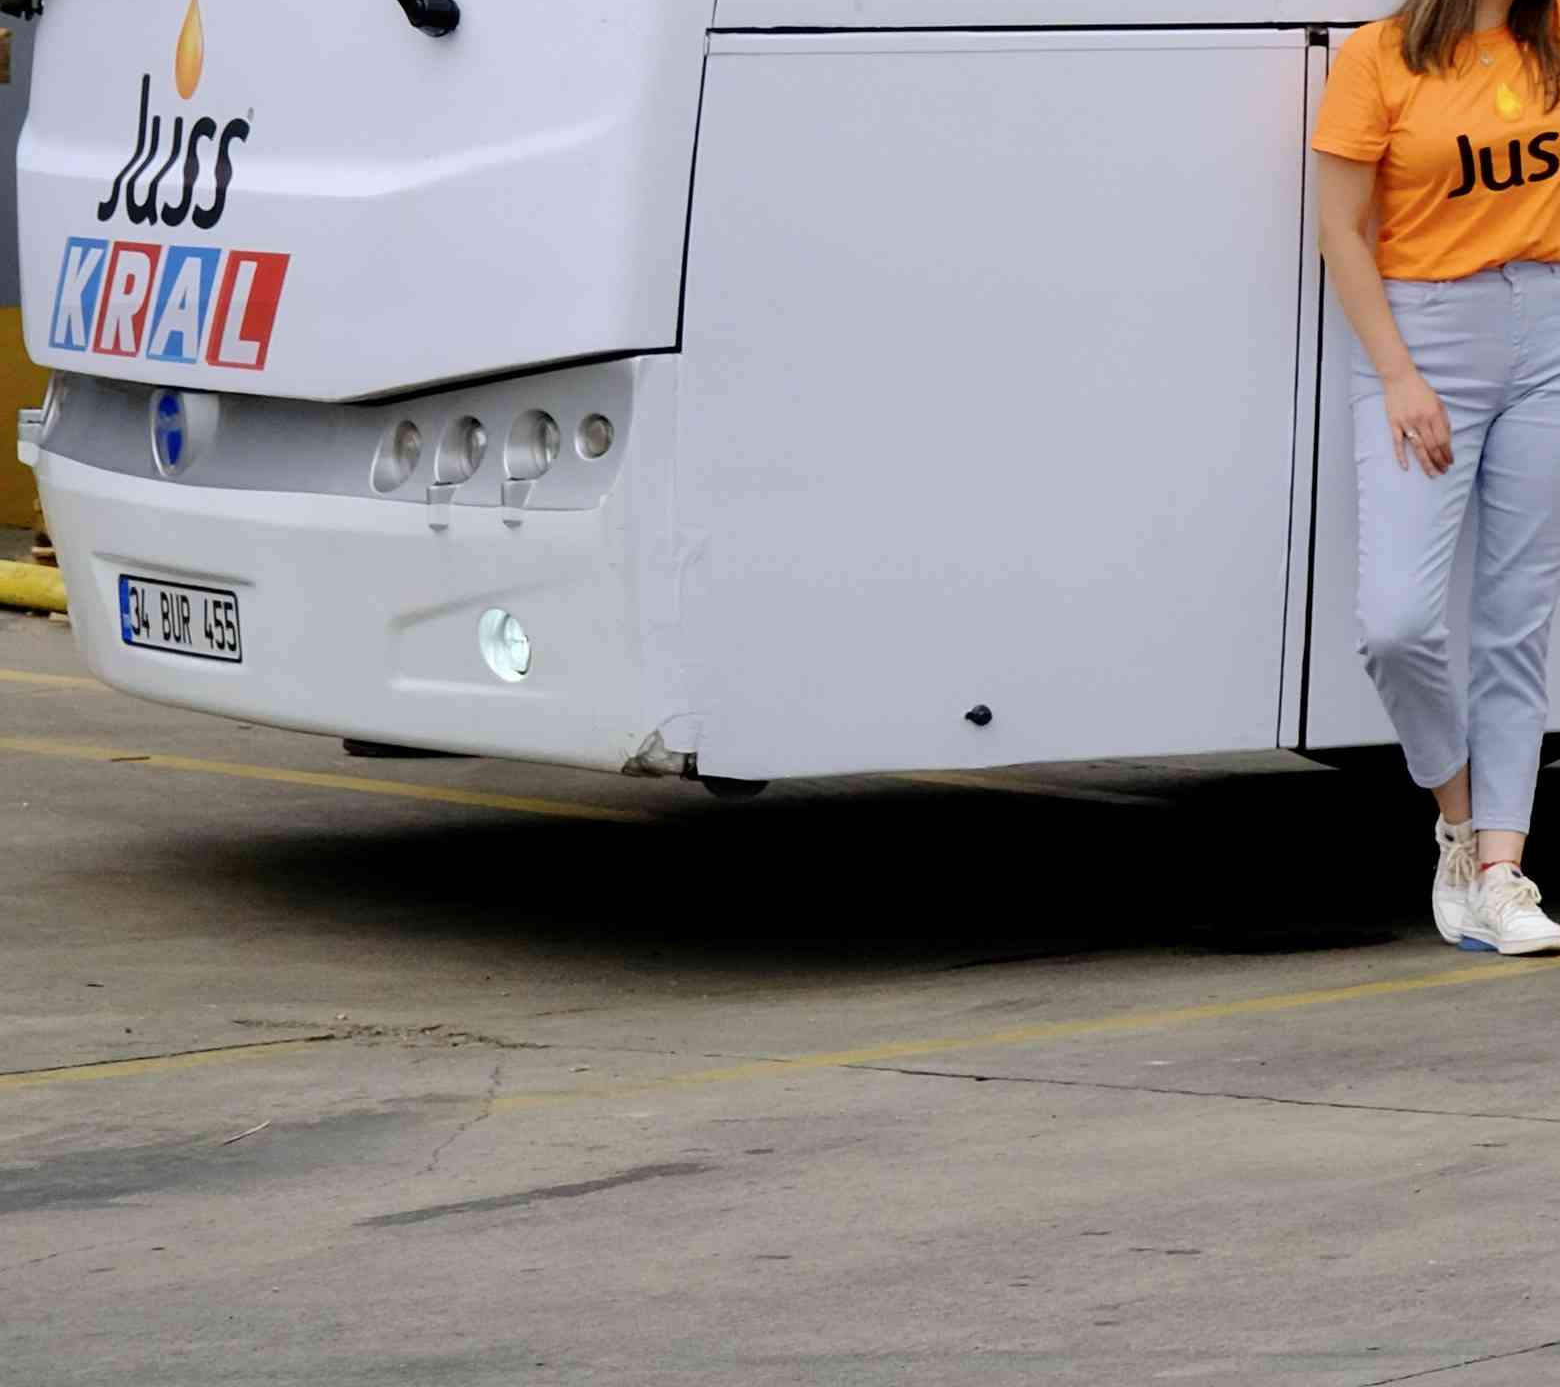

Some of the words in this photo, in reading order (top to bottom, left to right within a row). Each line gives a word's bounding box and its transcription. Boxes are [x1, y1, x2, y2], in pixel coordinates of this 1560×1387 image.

[98, 74, 251, 229] Juss
[54, 237, 268, 367] KRAL
[130, 586, 150, 639] 34
[160, 590, 193, 646] BUR
[204, 598, 237, 652] 455
